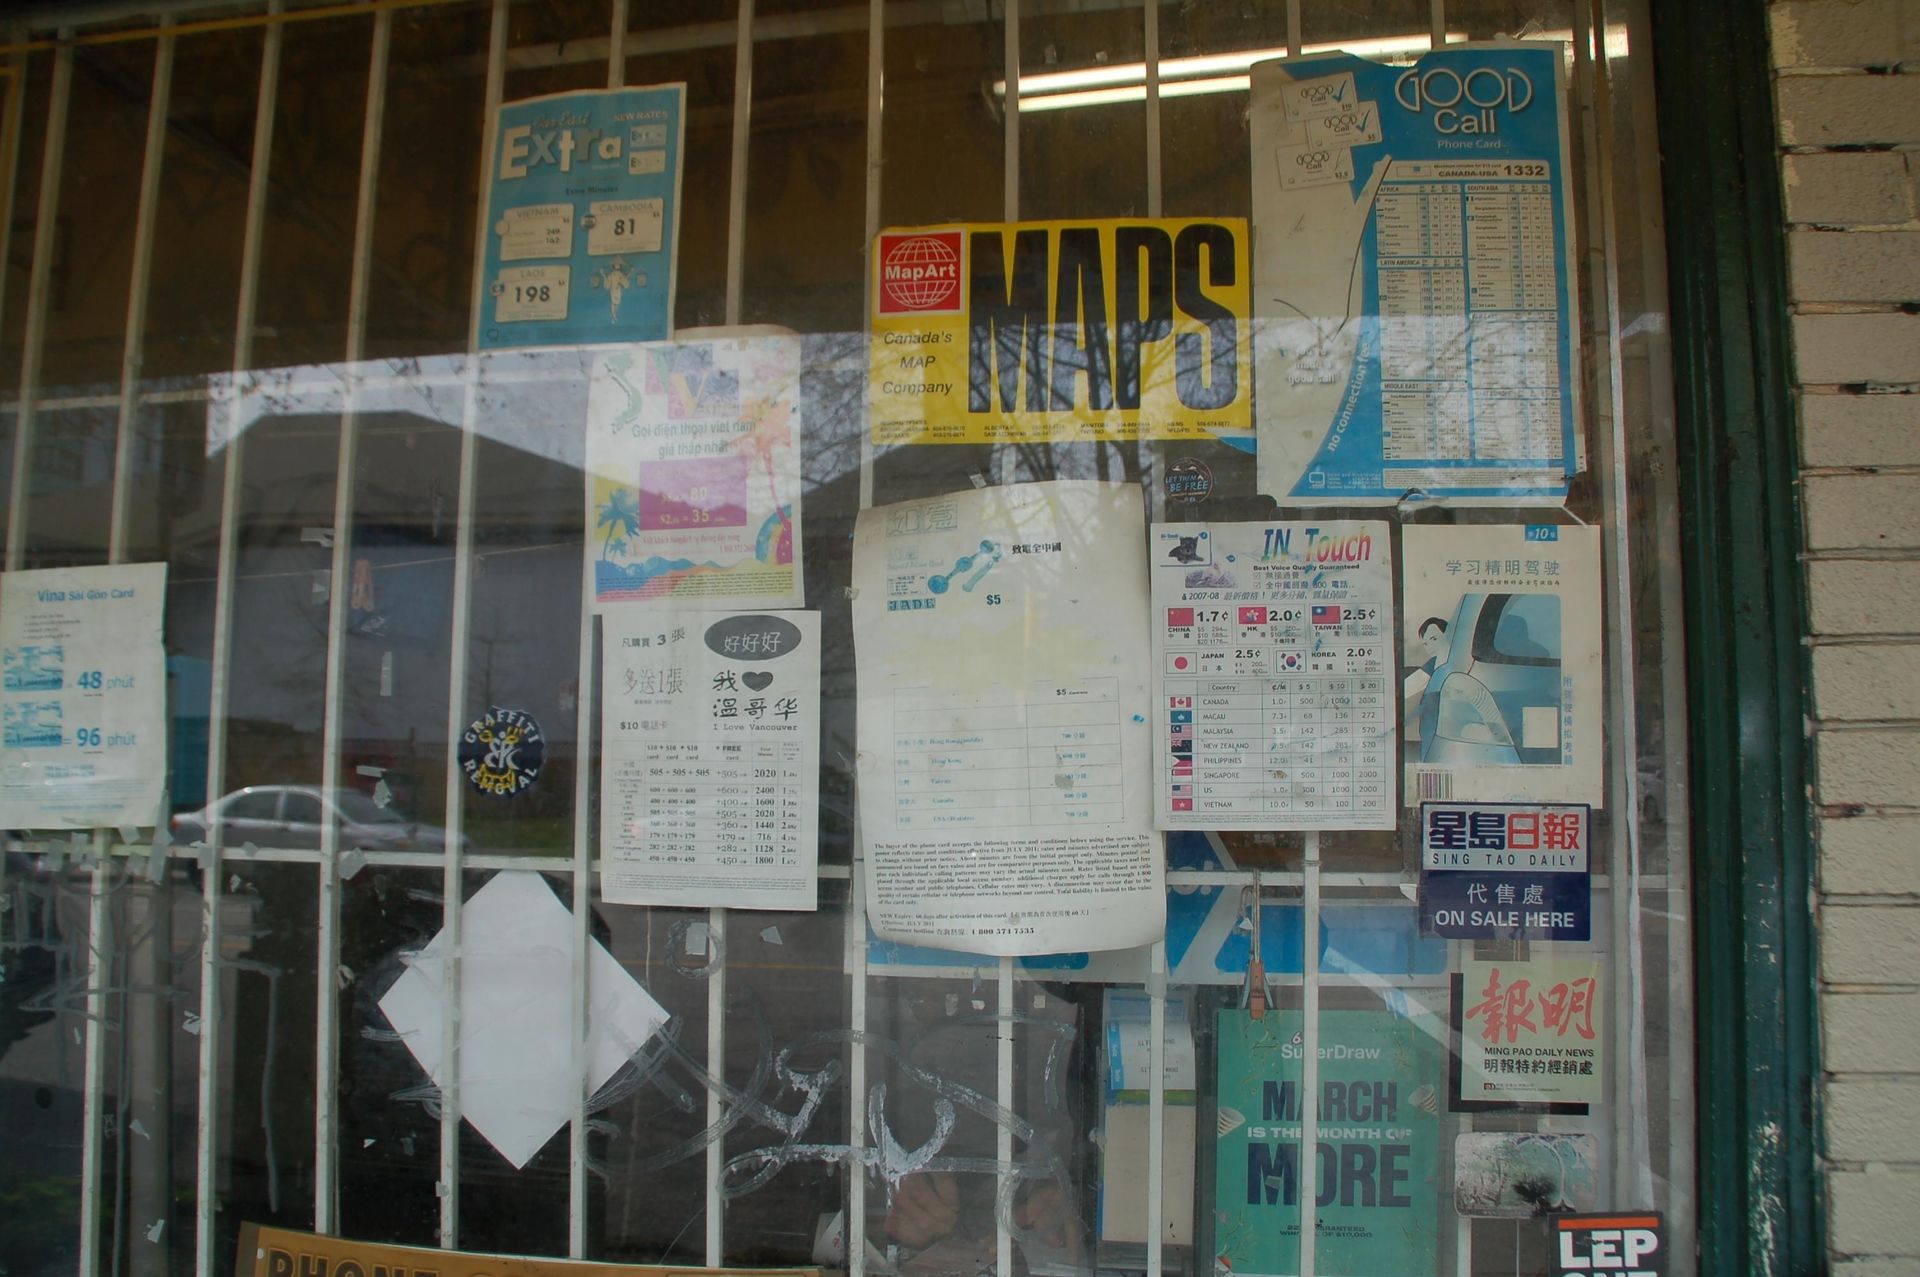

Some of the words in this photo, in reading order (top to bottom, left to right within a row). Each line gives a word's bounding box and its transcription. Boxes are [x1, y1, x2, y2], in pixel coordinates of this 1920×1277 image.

[1395, 68, 1533, 112] GOOD
[1434, 109, 1496, 133] Call
[1438, 139, 1473, 149] Phone
[1475, 139, 1501, 149] Card
[500, 125, 623, 180] Extra
[1504, 165, 1544, 176] 1332
[517, 207, 559, 218] VIETNAM
[599, 201, 655, 213] CAMBODIA
[613, 218, 636, 236] 81
[885, 263, 956, 281] MapArt
[514, 285, 550, 303] 198
[969, 224, 1237, 413] MAPS
[883, 330, 953, 345] Canada's
[899, 354, 936, 368] MAP
[882, 380, 953, 397] Company
[1327, 434, 1341, 452] no
[1337, 364, 1367, 433] connection
[1184, 480, 1208, 491] FREE
[691, 508, 710, 523] 35
[888, 503, 957, 536] 如意
[1261, 528, 1291, 563] IN
[1304, 526, 1372, 562] Touch
[1318, 563, 1360, 571] Guaranteed
[1445, 560, 1561, 577] 学习精明驾驶
[37, 590, 65, 602] Vina
[110, 588, 135, 599] Card
[986, 594, 1001, 606] $5
[1188, 592, 1220, 601] 2007-08
[888, 598, 936, 612] JADE
[622, 637, 650, 648] 凡購買
[657, 634, 666, 646] 3
[671, 626, 686, 643] 張
[724, 632, 782, 654] 好好好
[77, 671, 102, 690] 48
[623, 667, 684, 696] 多送1張
[712, 669, 739, 693] 我
[464, 709, 540, 744] GRAFFITI
[620, 721, 639, 731] $10
[713, 723, 718, 731] I
[723, 723, 745, 731] Love
[749, 723, 798, 731] Vancouver
[76, 728, 100, 747] 96
[106, 730, 136, 747] phút
[649, 768, 663, 776] 505
[672, 769, 686, 777] 505
[695, 769, 710, 777] 505
[754, 769, 776, 778] 2020
[755, 786, 775, 795] 2400
[755, 798, 775, 806] 1600
[755, 809, 775, 818] 2020
[755, 821, 775, 830] 1440
[1428, 810, 1580, 851] 星島日報
[757, 832, 772, 841] 716
[755, 845, 774, 853] 1128
[755, 856, 774, 865] 1800
[1433, 853, 1471, 865] SING
[1486, 854, 1515, 866] TAO
[1530, 855, 1576, 867] DAILY
[1466, 883, 1545, 905] 代售處
[1435, 910, 1465, 926] ON
[1471, 911, 1519, 927] SALE
[1525, 912, 1575, 928] HERE
[1281, 1044, 1381, 1060] SuerDraw
[1484, 1047, 1510, 1056] MING
[1512, 1048, 1533, 1056] PAO
[1535, 1048, 1563, 1057] DAILY
[1565, 1048, 1594, 1057] NEWS
[1484, 1059, 1593, 1075] 明報特約經銷處
[1247, 1126, 1266, 1139] IS
[1270, 1127, 1303, 1139] THE
[1316, 1127, 1381, 1140] MONTH
[1385, 1128, 1413, 1140] OF
[1559, 1229, 1659, 1269] LEP
